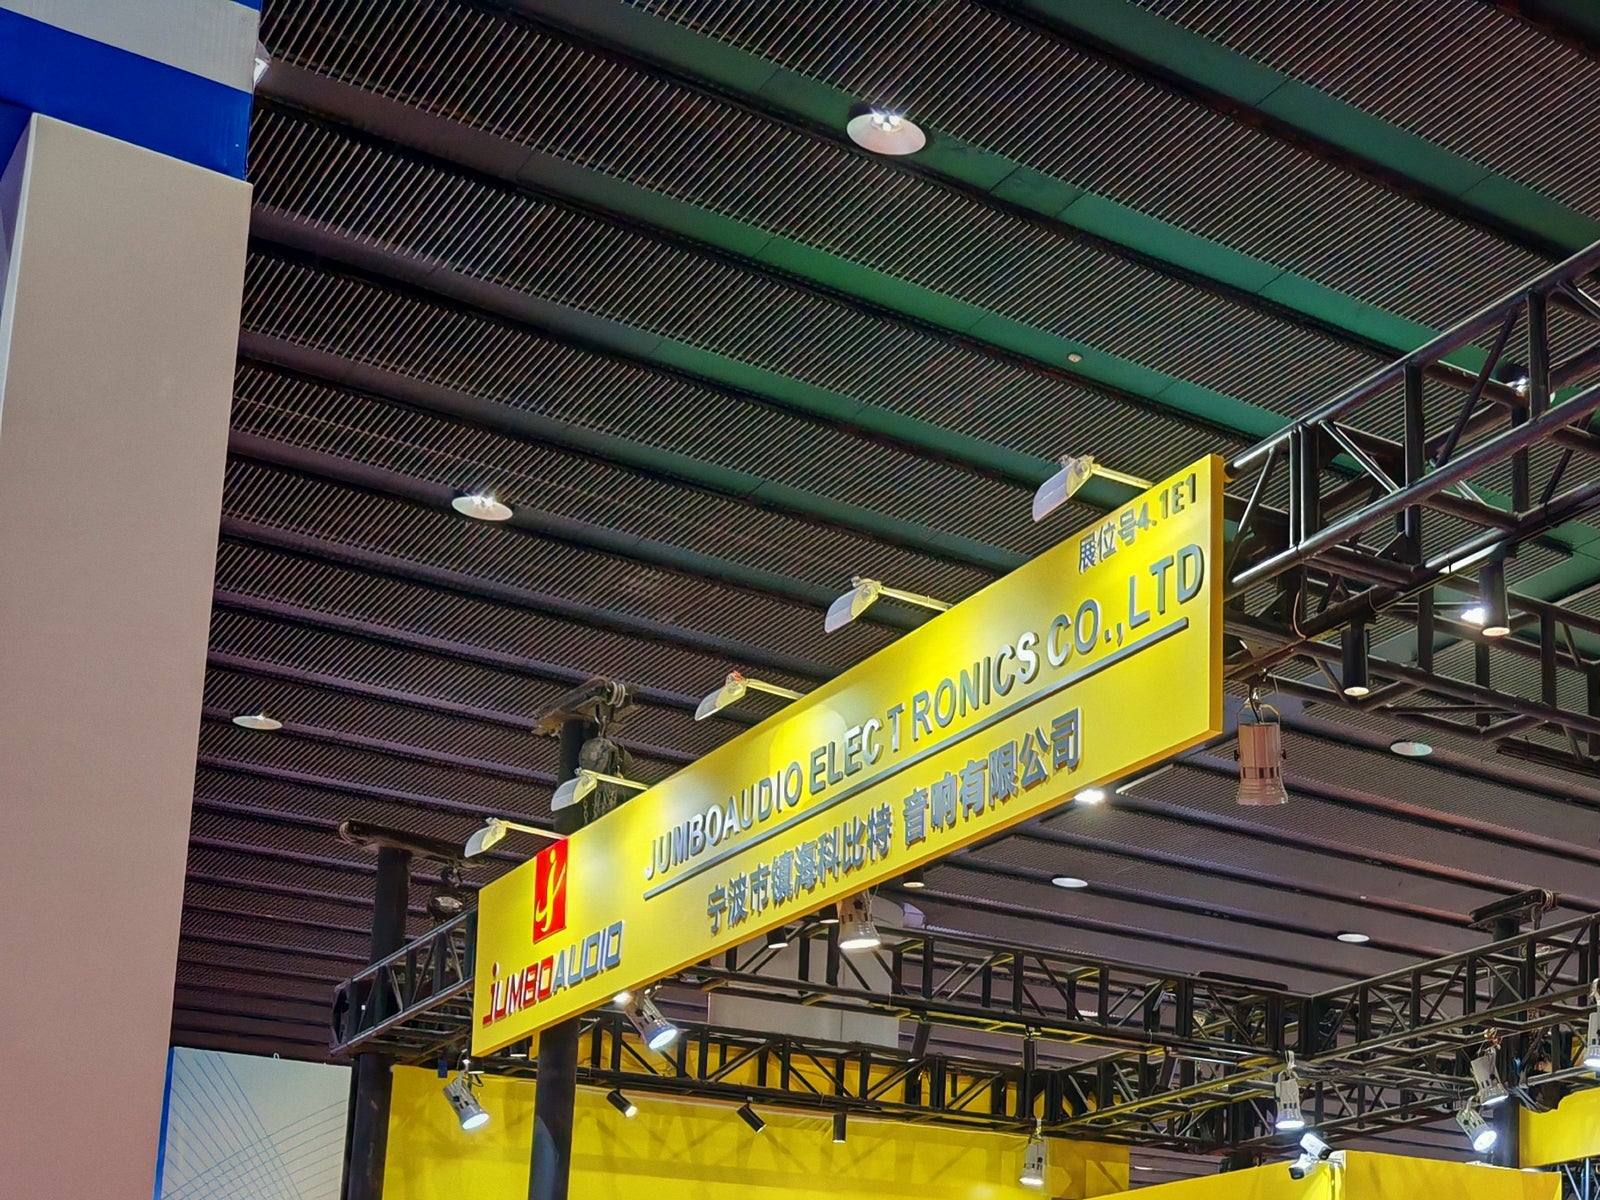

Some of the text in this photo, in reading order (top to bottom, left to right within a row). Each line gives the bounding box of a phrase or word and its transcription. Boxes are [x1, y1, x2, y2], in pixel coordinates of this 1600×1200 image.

[1078, 473, 1197, 573] 展位号4.1E1
[643, 761, 803, 880] JUMBOAUDIO
[902, 706, 1084, 848] 音响有限公司
